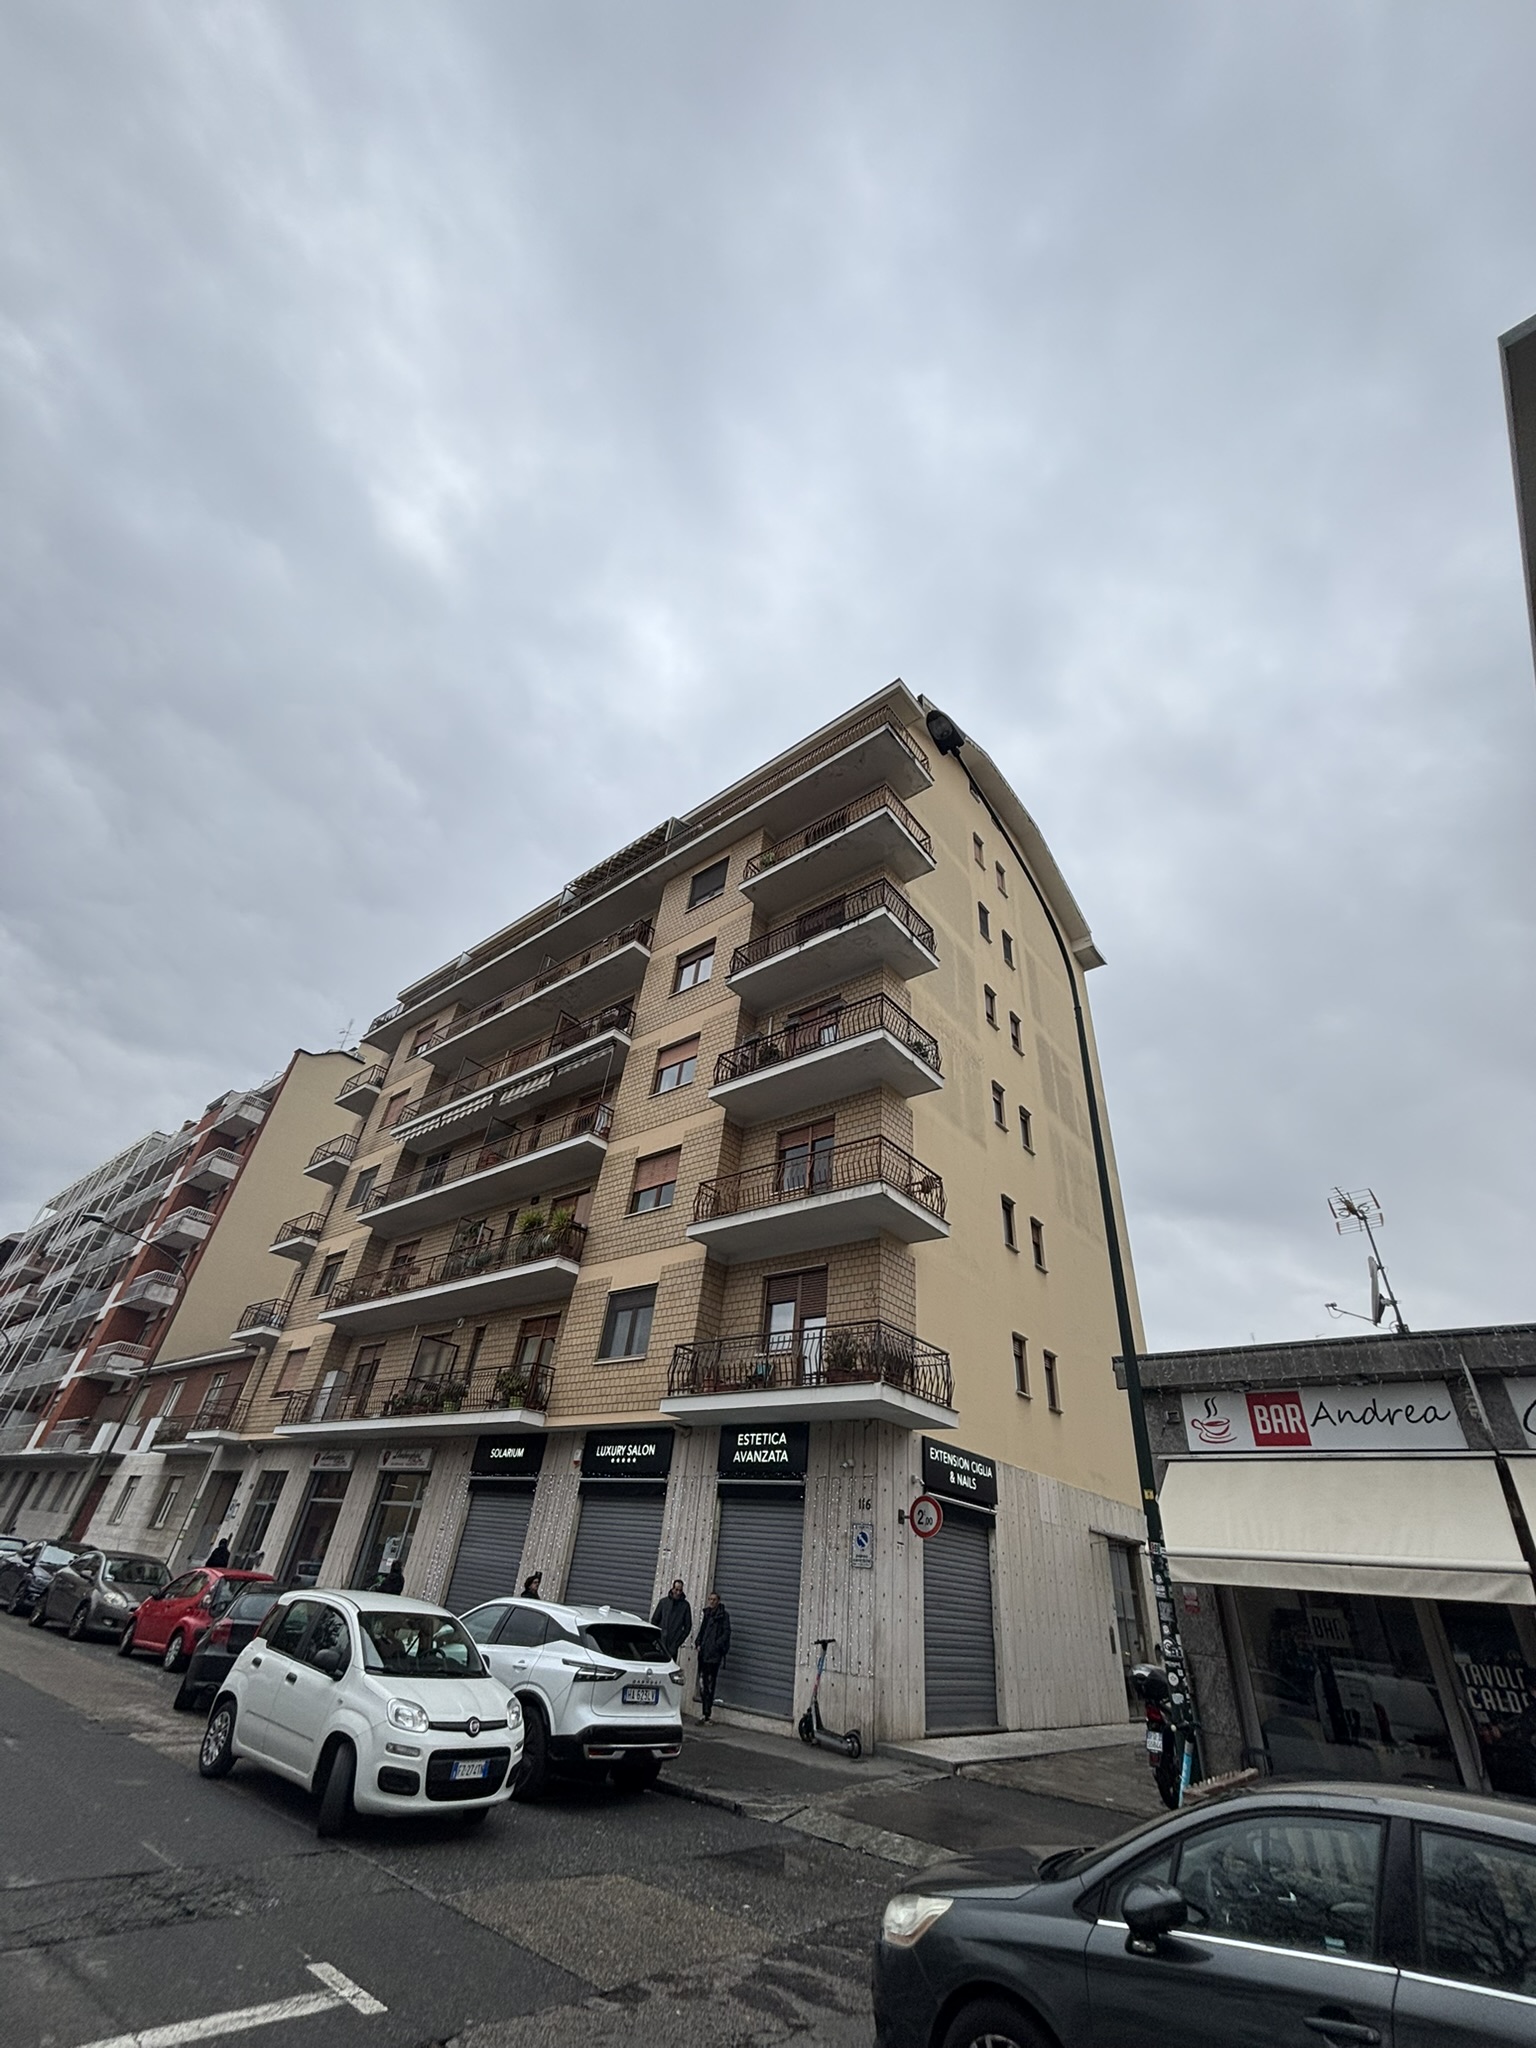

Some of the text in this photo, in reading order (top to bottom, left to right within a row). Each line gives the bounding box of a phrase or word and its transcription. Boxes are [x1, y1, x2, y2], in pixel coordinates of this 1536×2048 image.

[1253, 1398, 1451, 1434] BAR Andrea
[737, 1432, 787, 1446] ESTETICA
[490, 1447, 525, 1458] SOLARIUM
[596, 1444, 656, 1457] LUXURY SALON
[732, 1450, 789, 1463] AVANZATA
[930, 1446, 993, 1478] EXTENSION CIGLIA
[949, 1470, 977, 1490] & NAILS
